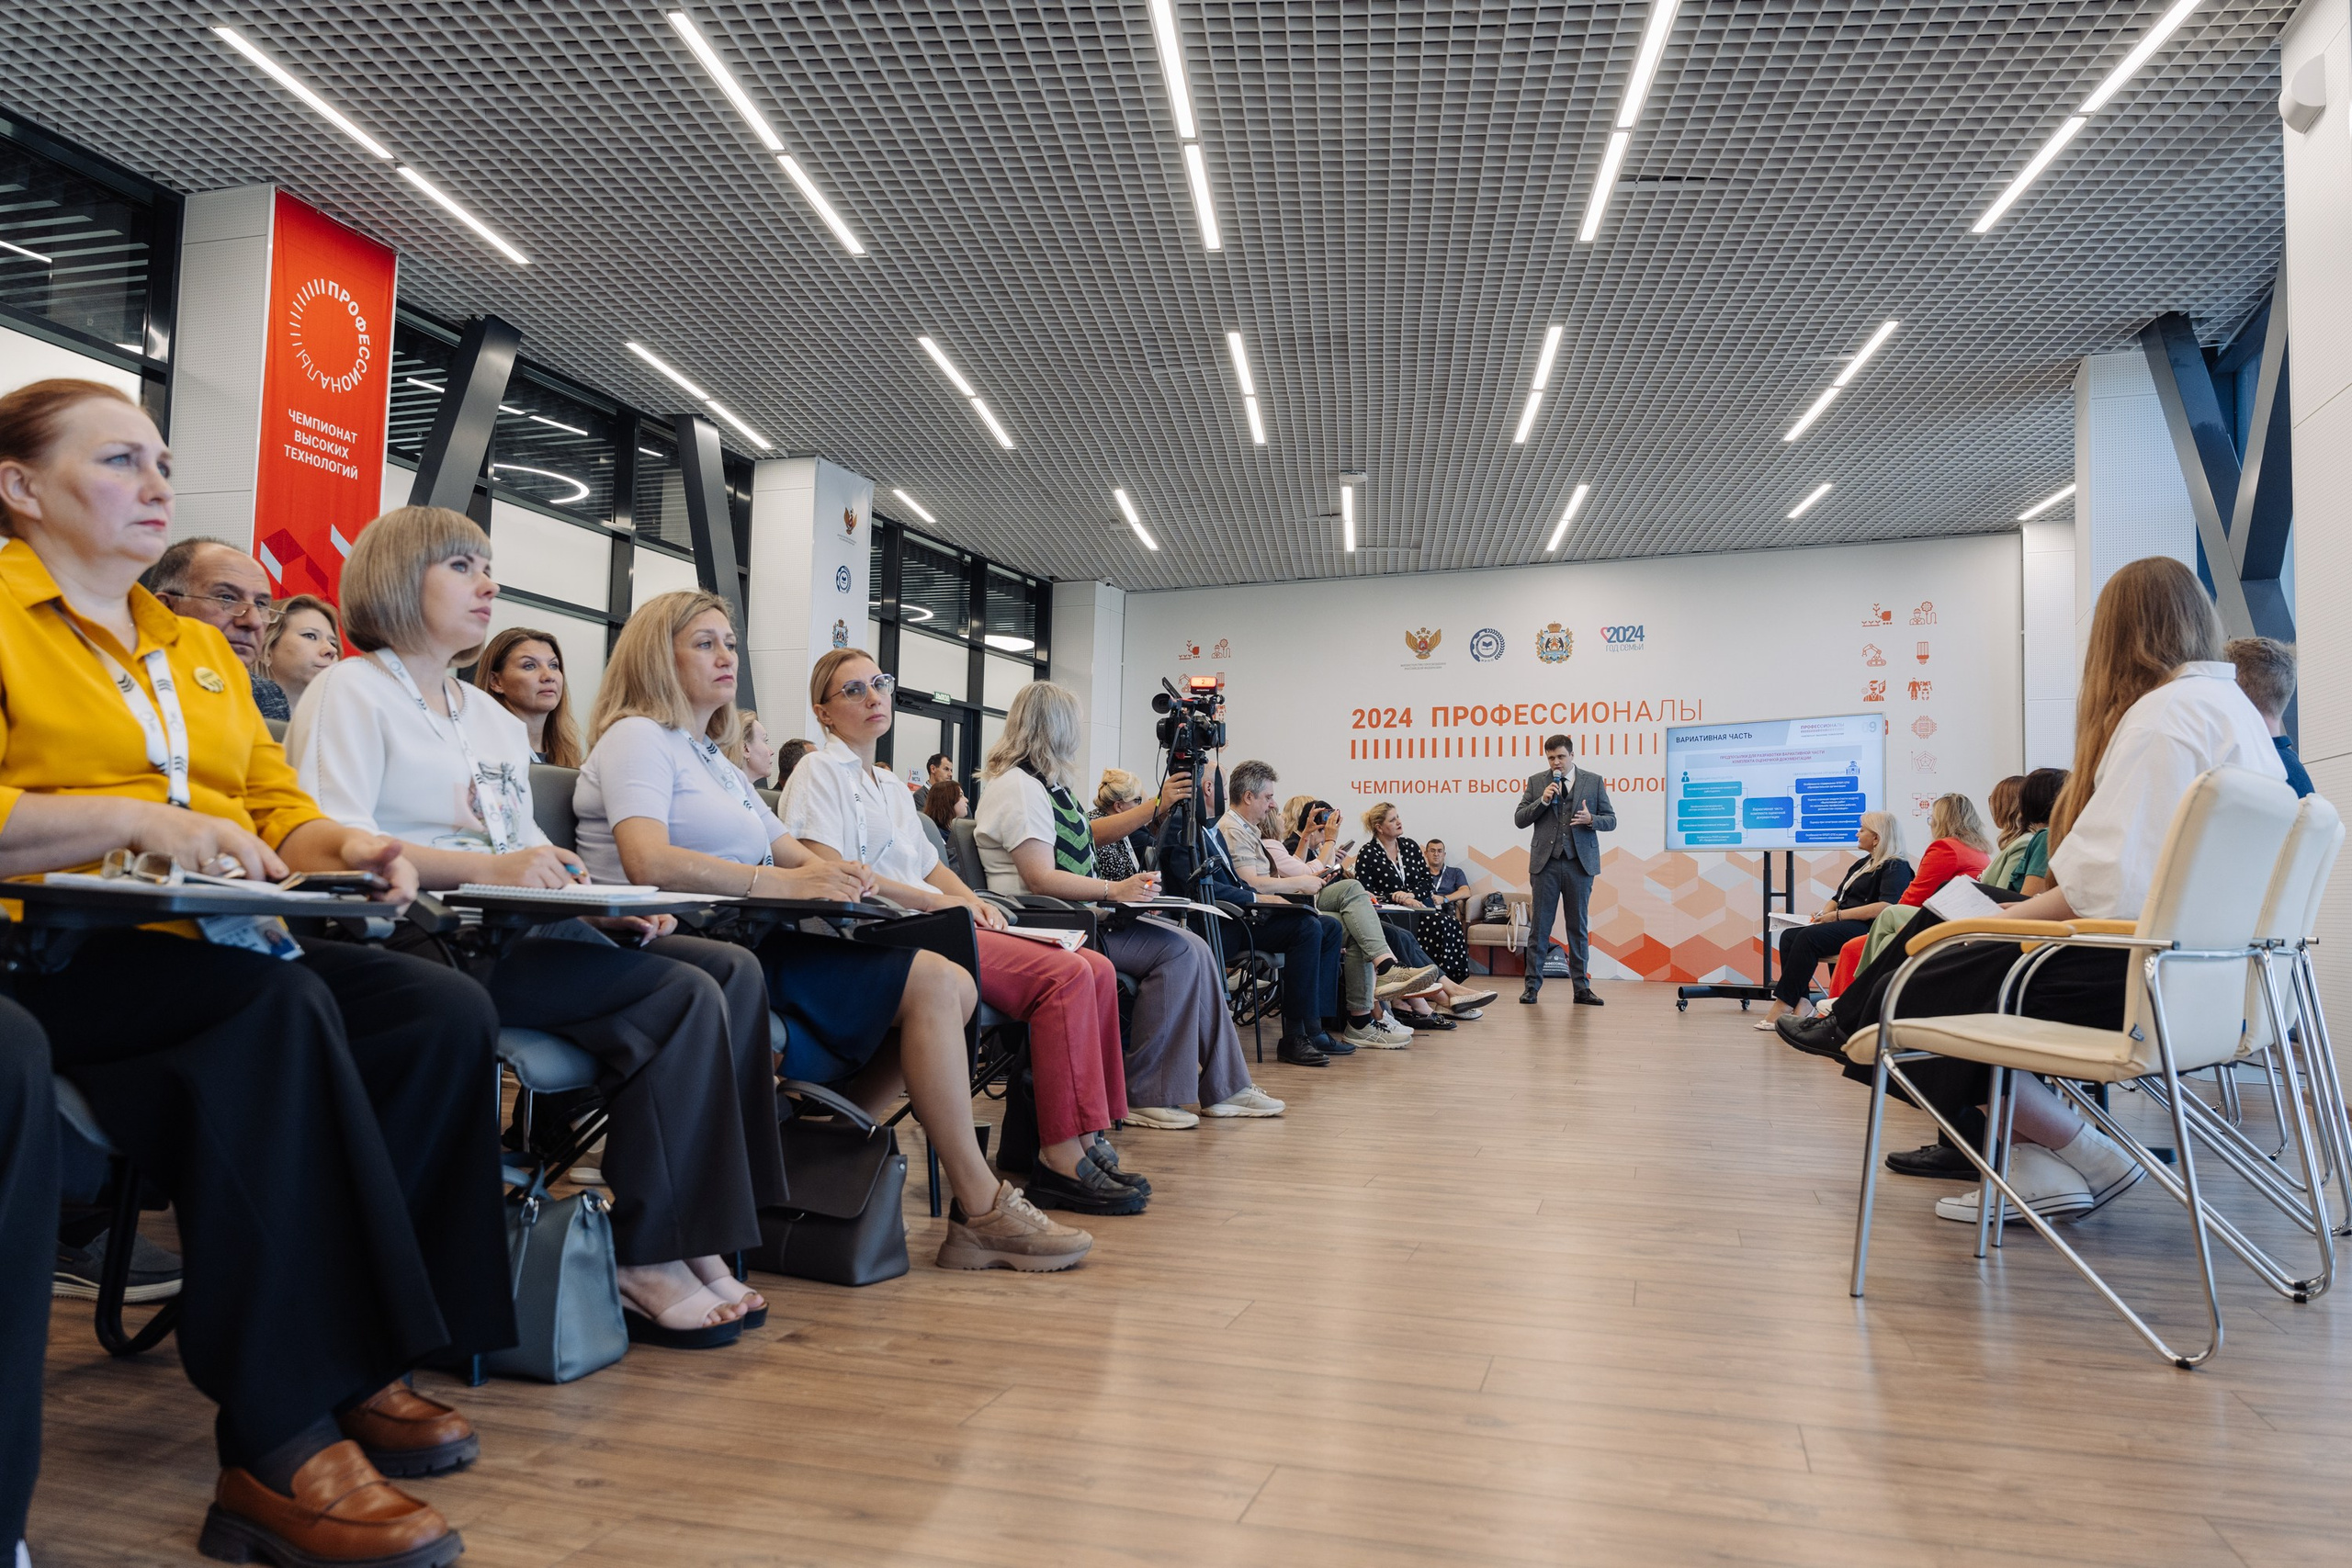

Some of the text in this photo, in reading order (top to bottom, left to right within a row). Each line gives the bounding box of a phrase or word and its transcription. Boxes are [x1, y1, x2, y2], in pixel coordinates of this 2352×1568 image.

[296, 280, 370, 393] ПРОФЕССИОНАЛЫ
[288, 408, 358, 445] ЧЕМПИОНАТ
[294, 429, 349, 460] ВЫСОКИХ
[283, 444, 358, 480] ТЕХНОЛОГИЙ
[1606, 625, 1645, 644] 2024
[1351, 699, 1702, 729] 2024 ПРОФЕССИОНАЛЫ
[1676, 732, 1753, 743] ВАРИАТИВНАЯ ЧАСТЬ
[1351, 779, 1463, 795] ЧЕМПИОНАТ
[1468, 779, 1528, 794] ВЫСО
